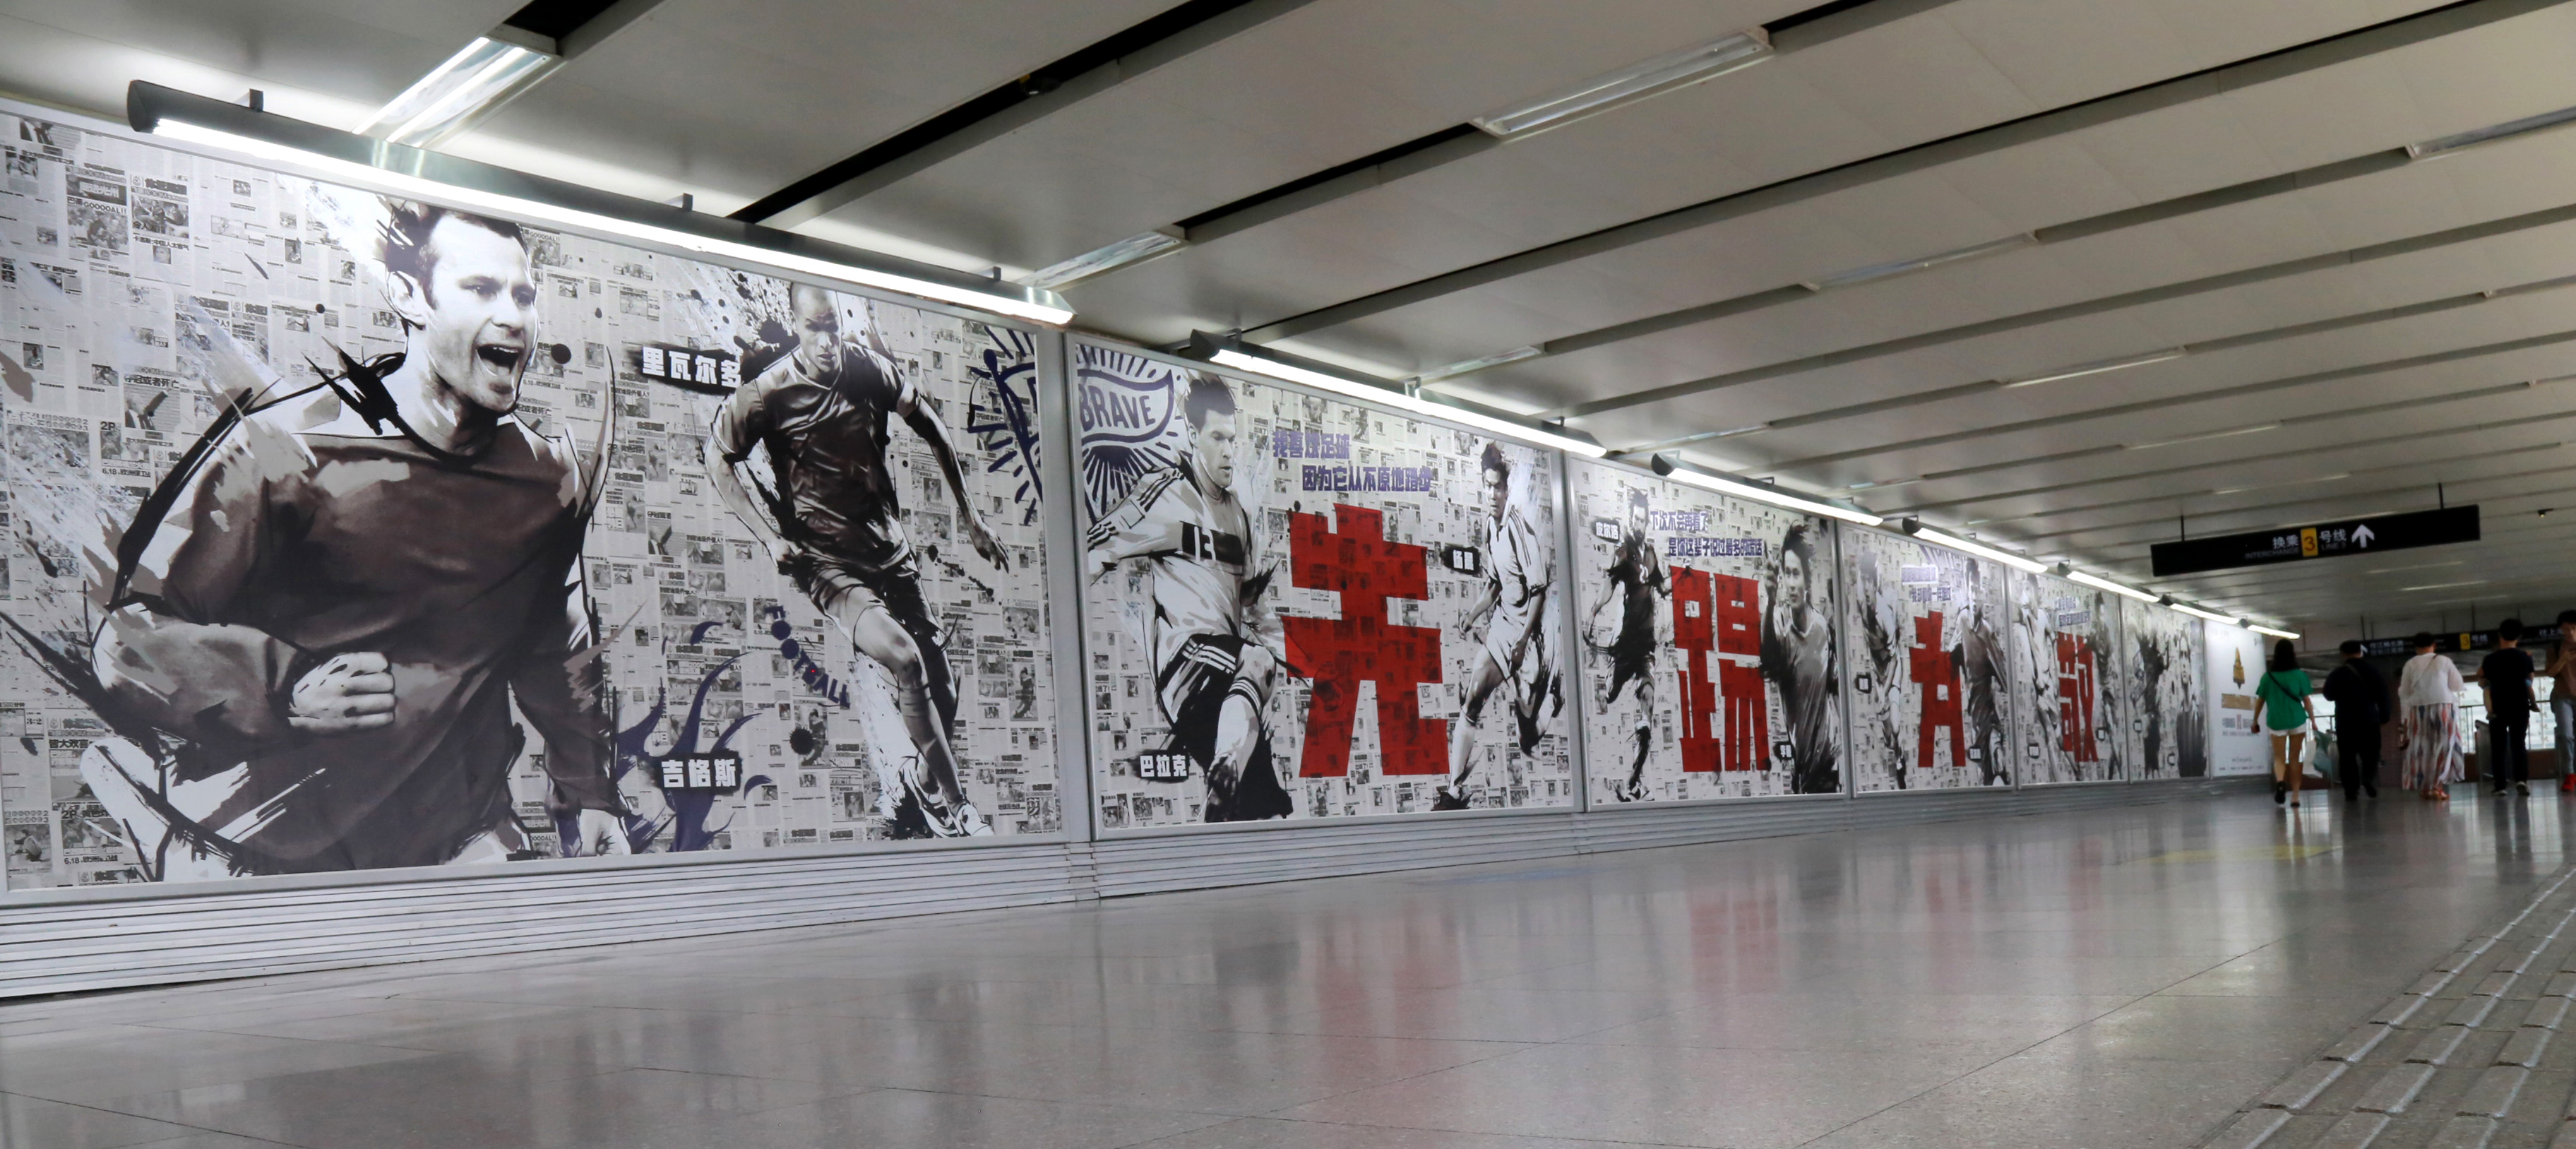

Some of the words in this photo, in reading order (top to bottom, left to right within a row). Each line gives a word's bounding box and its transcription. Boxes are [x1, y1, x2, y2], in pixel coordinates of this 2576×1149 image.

[642, 346, 741, 388] 里瓦尔多
[1078, 383, 1156, 432] BRAVE
[1273, 430, 1350, 459] 我喜欢足球
[1302, 465, 1433, 492] 因为它从不原地踏步
[1650, 511, 1708, 531] 下次不会再看了
[1669, 537, 1763, 557] 是你这辈子说过最多的谎话
[2272, 535, 2298, 549] 换乘
[2304, 536, 2316, 552] 3
[2320, 529, 2347, 543] 号线
[1280, 503, 1450, 778] 先
[1669, 565, 1770, 772] 踢
[661, 758, 736, 788] 吉格斯
[1140, 754, 1187, 777] 巴拉克
